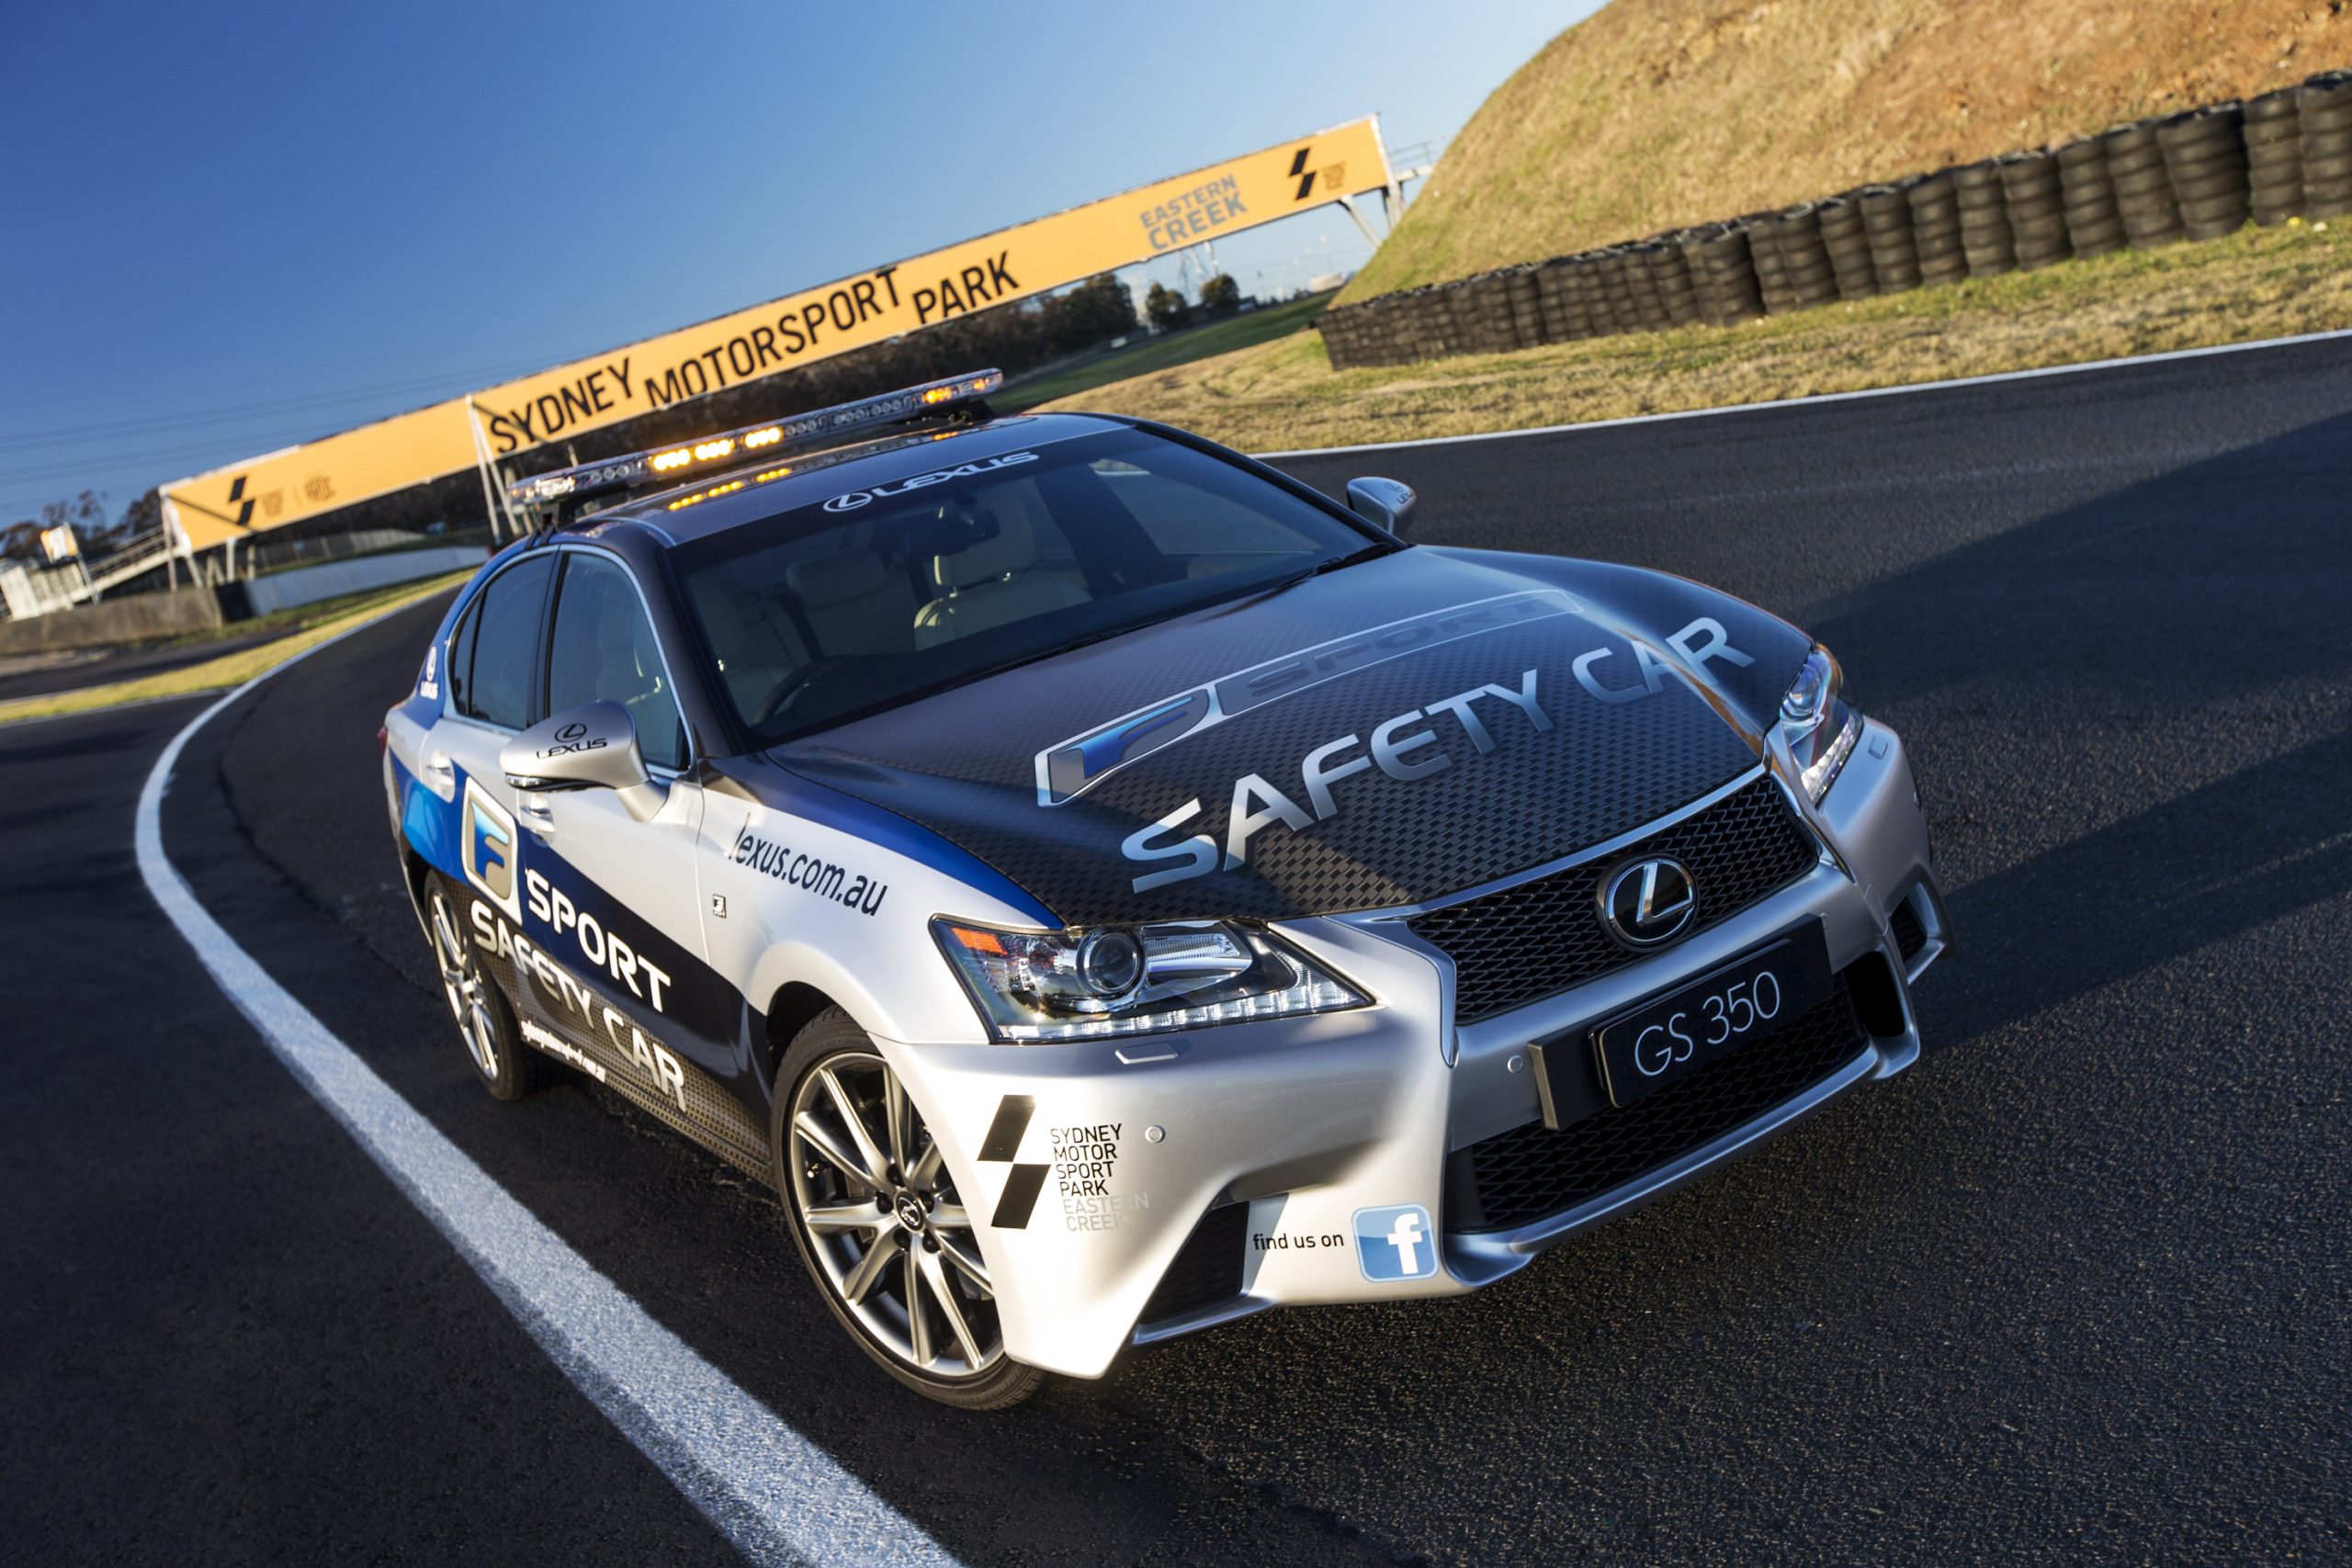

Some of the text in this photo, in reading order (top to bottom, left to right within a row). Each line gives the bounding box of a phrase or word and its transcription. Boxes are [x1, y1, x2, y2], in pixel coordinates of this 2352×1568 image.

[1140, 175, 1238, 228] EASTERN
[1148, 191, 1247, 250] CREEK
[490, 251, 1020, 454] SYDNEY MOTORSPORT PARK
[871, 451, 1039, 497] LEXUS
[1246, 597, 1545, 696] SPORT
[537, 738, 607, 759] LEXUS
[1121, 617, 1755, 894] SAFETY CAR
[728, 812, 888, 917] lexus.com.au
[526, 869, 671, 1013] SPORT
[470, 899, 594, 1029] SAFETY
[604, 1008, 686, 1113] CAR
[1634, 971, 1781, 1077] GS 350
[1050, 1122, 1122, 1145] SYDNEY
[1054, 1143, 1118, 1162] MOTOR
[1056, 1161, 1114, 1179] SPORT
[1059, 1179, 1110, 1197] PARK
[1063, 1192, 1149, 1214] EASTERN
[1067, 1213, 1127, 1232] CREEK
[1252, 1234, 1288, 1251] find
[1294, 1235, 1317, 1249] us
[1320, 1234, 1345, 1247] on
